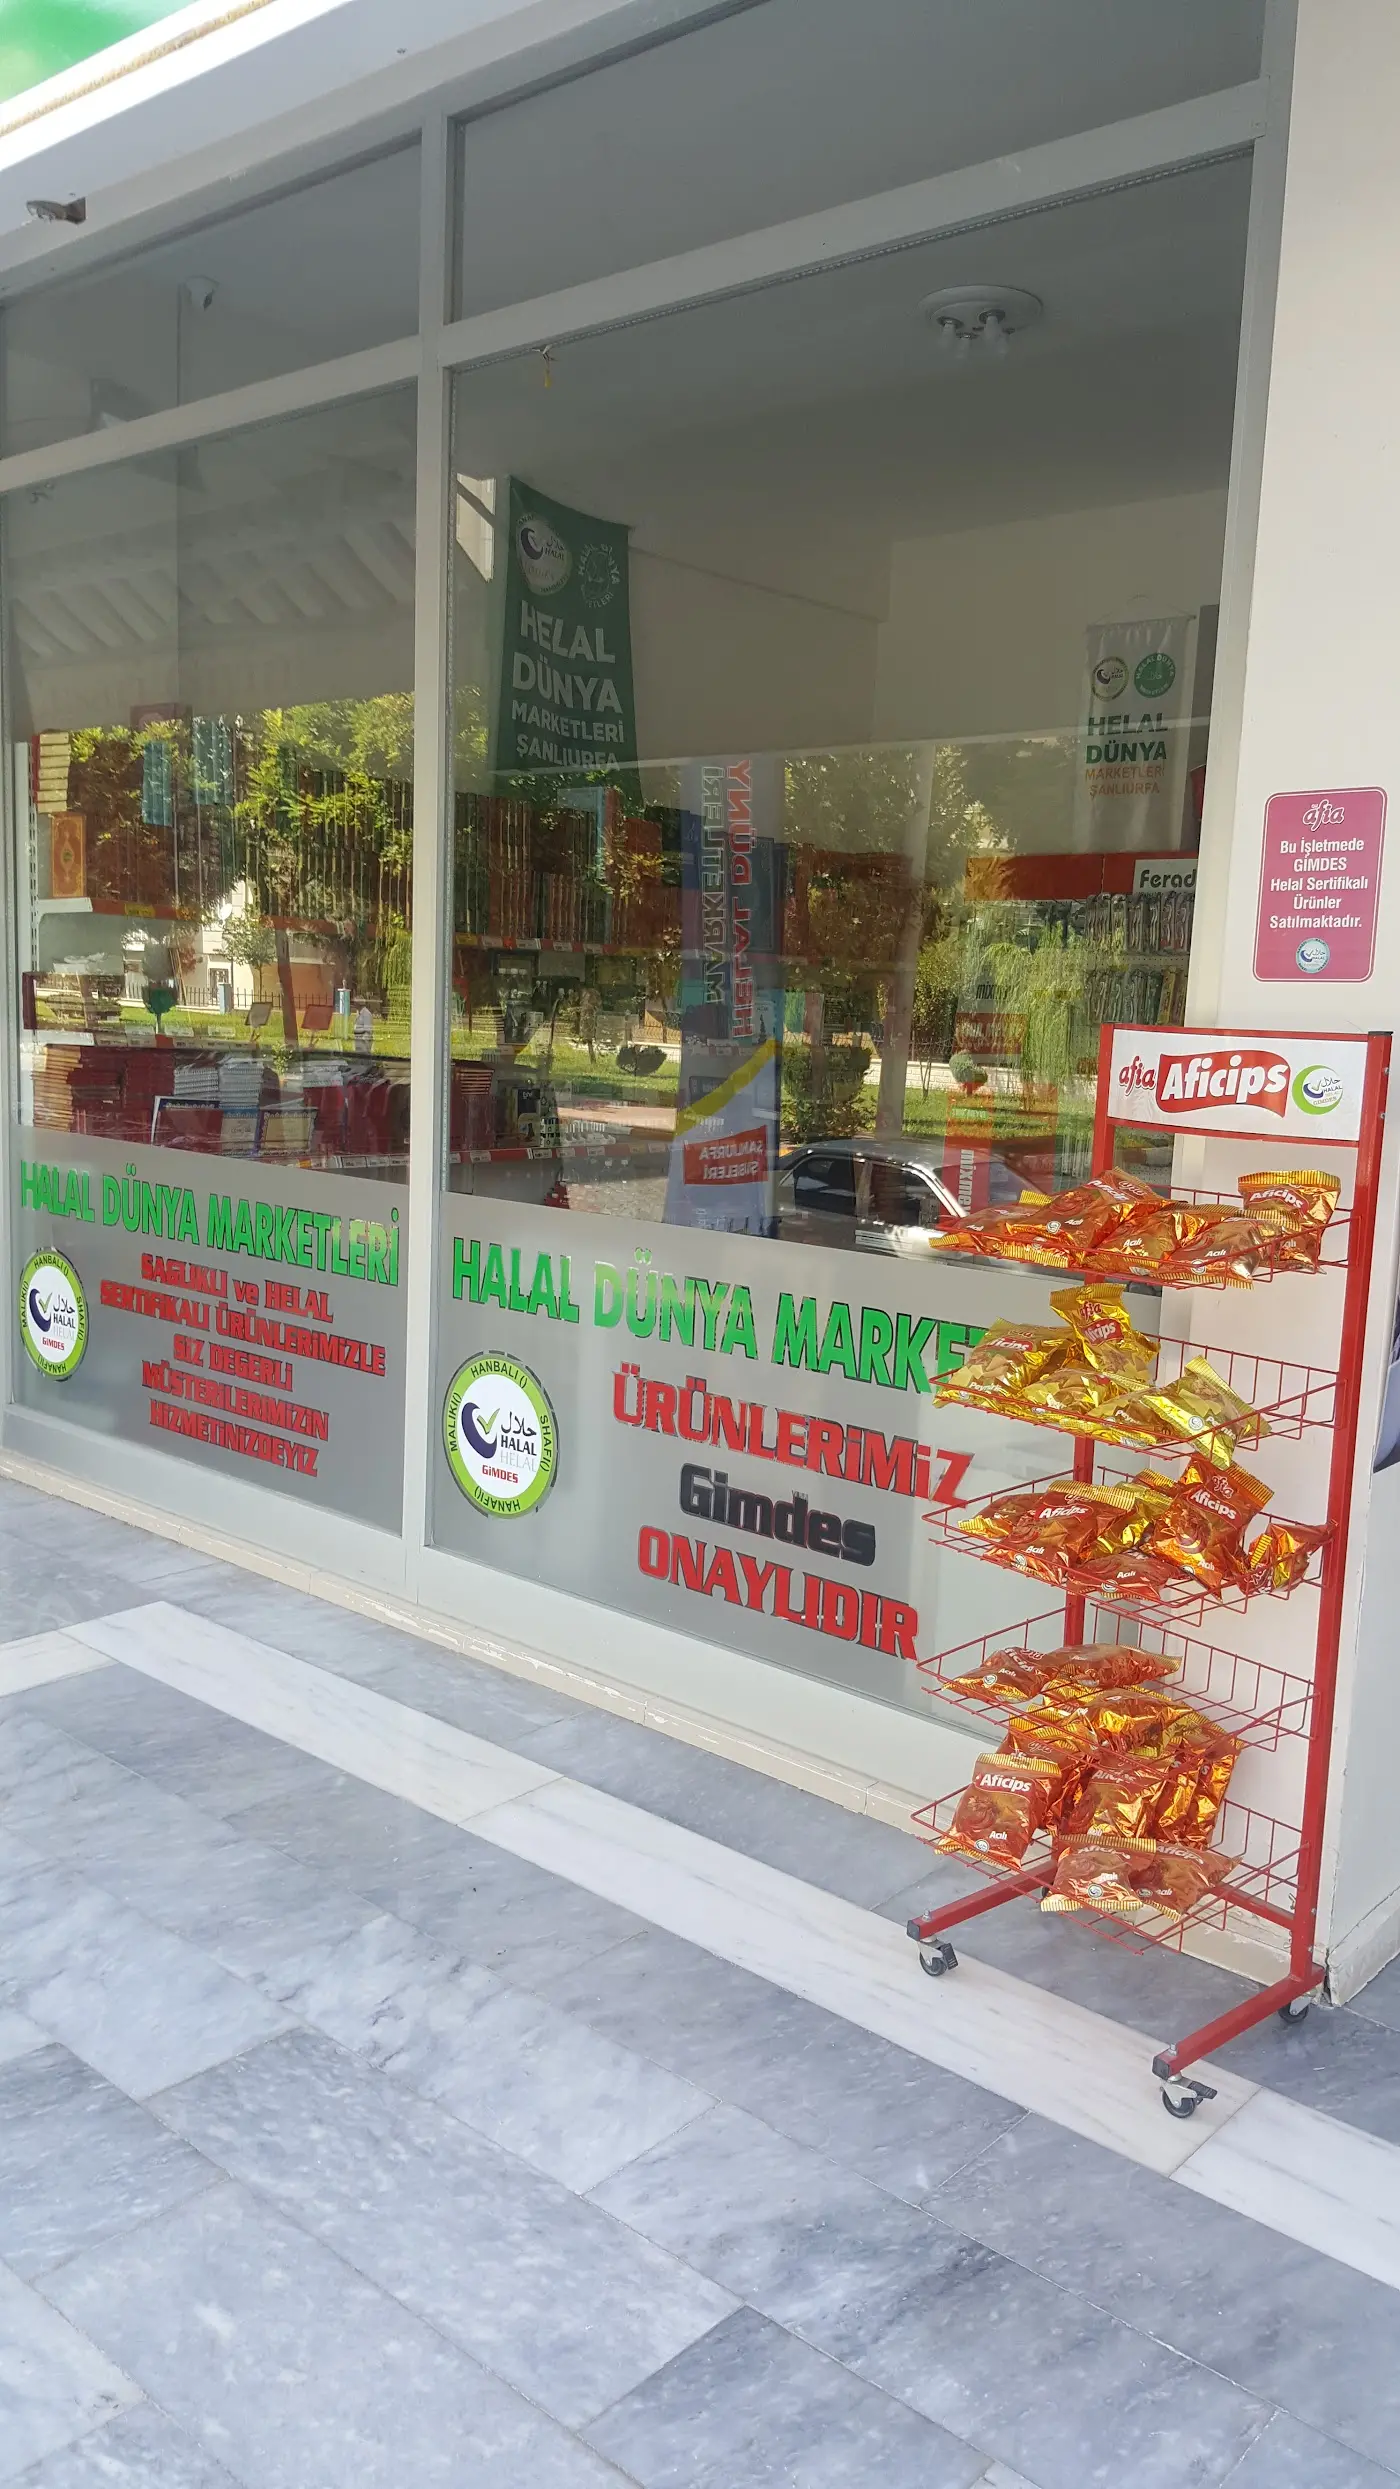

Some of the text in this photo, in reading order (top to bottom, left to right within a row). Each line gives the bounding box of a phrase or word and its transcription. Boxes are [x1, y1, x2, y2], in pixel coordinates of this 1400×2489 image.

[520, 600, 616, 664] HELAL
[512, 652, 623, 714] DÜNYA
[512, 700, 624, 743] MARKETLERİ
[1087, 713, 1168, 736] HELAL
[516, 735, 621, 771] ŞANLIURFA
[1086, 740, 1167, 764] DÜNYA
[1085, 765, 1165, 781] MARKETLERİ
[1089, 782, 1160, 799] ŞANLIURFA
[1280, 837, 1364, 858] Bu İşletmede
[1294, 856, 1347, 872] GİMDES
[1270, 877, 1368, 892] Helal Sertifikalı
[1294, 894, 1341, 910] Ürünler
[1269, 914, 1362, 929] Satılmaktadır.
[1118, 1055, 1156, 1096] afia
[1161, 1054, 1289, 1104] Aficips
[1322, 1085, 1342, 1094] HALAL
[1249, 1188, 1304, 1210] Aficips
[20, 1160, 400, 1287] HALAL DÜNYA MARKETLERİ
[53, 1294, 76, 1313] حلال
[233, 1279, 259, 1306] ve
[264, 1279, 333, 1324] HELAL
[452, 1237, 579, 1324] HALAL
[593, 1248, 759, 1359] DÜNYA
[53, 1312, 76, 1329] HALAL
[470, 1360, 518, 1380] HANBALI
[500, 1411, 537, 1437] حلال
[501, 1435, 537, 1456] HALAL
[500, 1450, 537, 1473] HELAL
[679, 1461, 876, 1567] Gimdes
[1038, 1505, 1089, 1519] Aficips
[1190, 1490, 1237, 1521] Aficips
[638, 1524, 919, 1661] ONAYLIDIR
[980, 1773, 1032, 1793] Aficips
